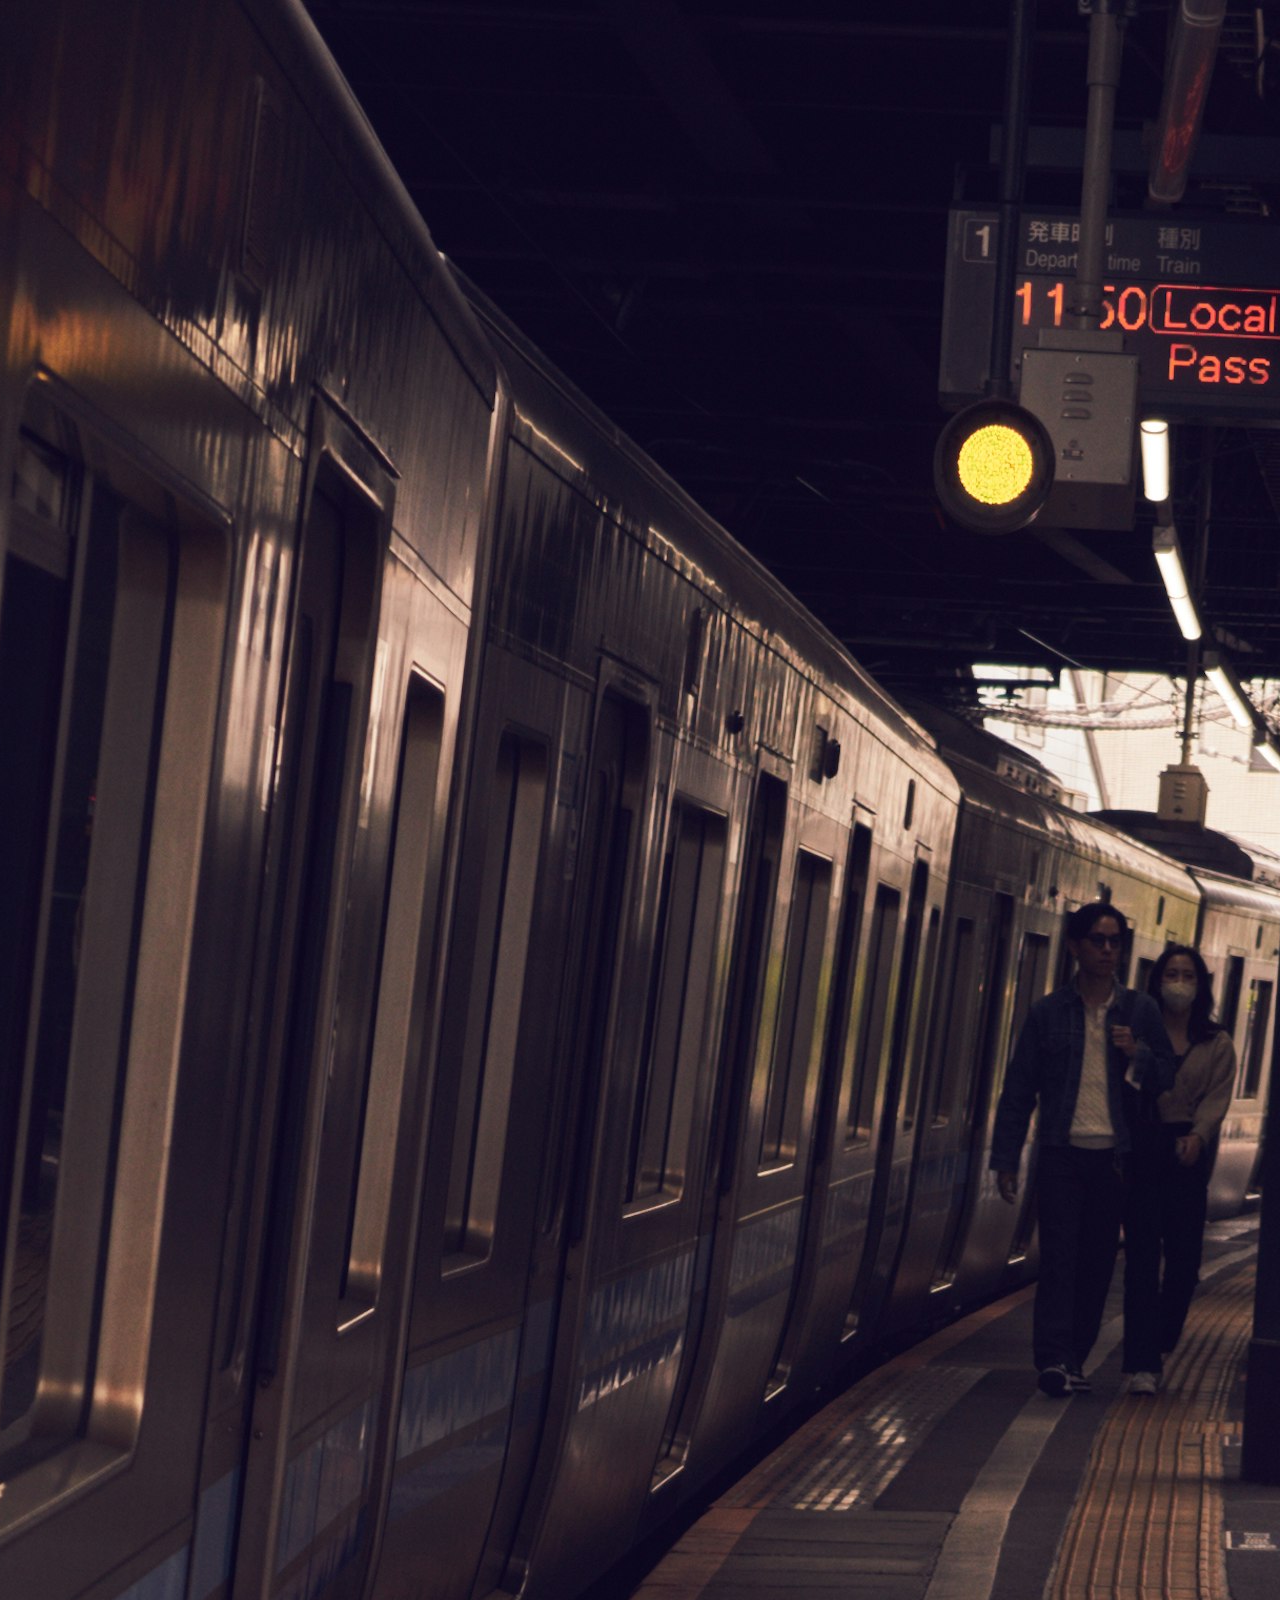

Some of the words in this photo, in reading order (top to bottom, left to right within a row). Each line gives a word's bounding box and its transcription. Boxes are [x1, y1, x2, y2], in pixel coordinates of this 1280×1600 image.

[975, 226, 991, 258] 1
[1158, 228, 1201, 251] 種別
[1108, 255, 1141, 272] time
[1157, 256, 1201, 275] Train
[1015, 281, 1148, 332] 1150
[1163, 291, 1278, 335] Local
[1168, 344, 1271, 386] Pass
